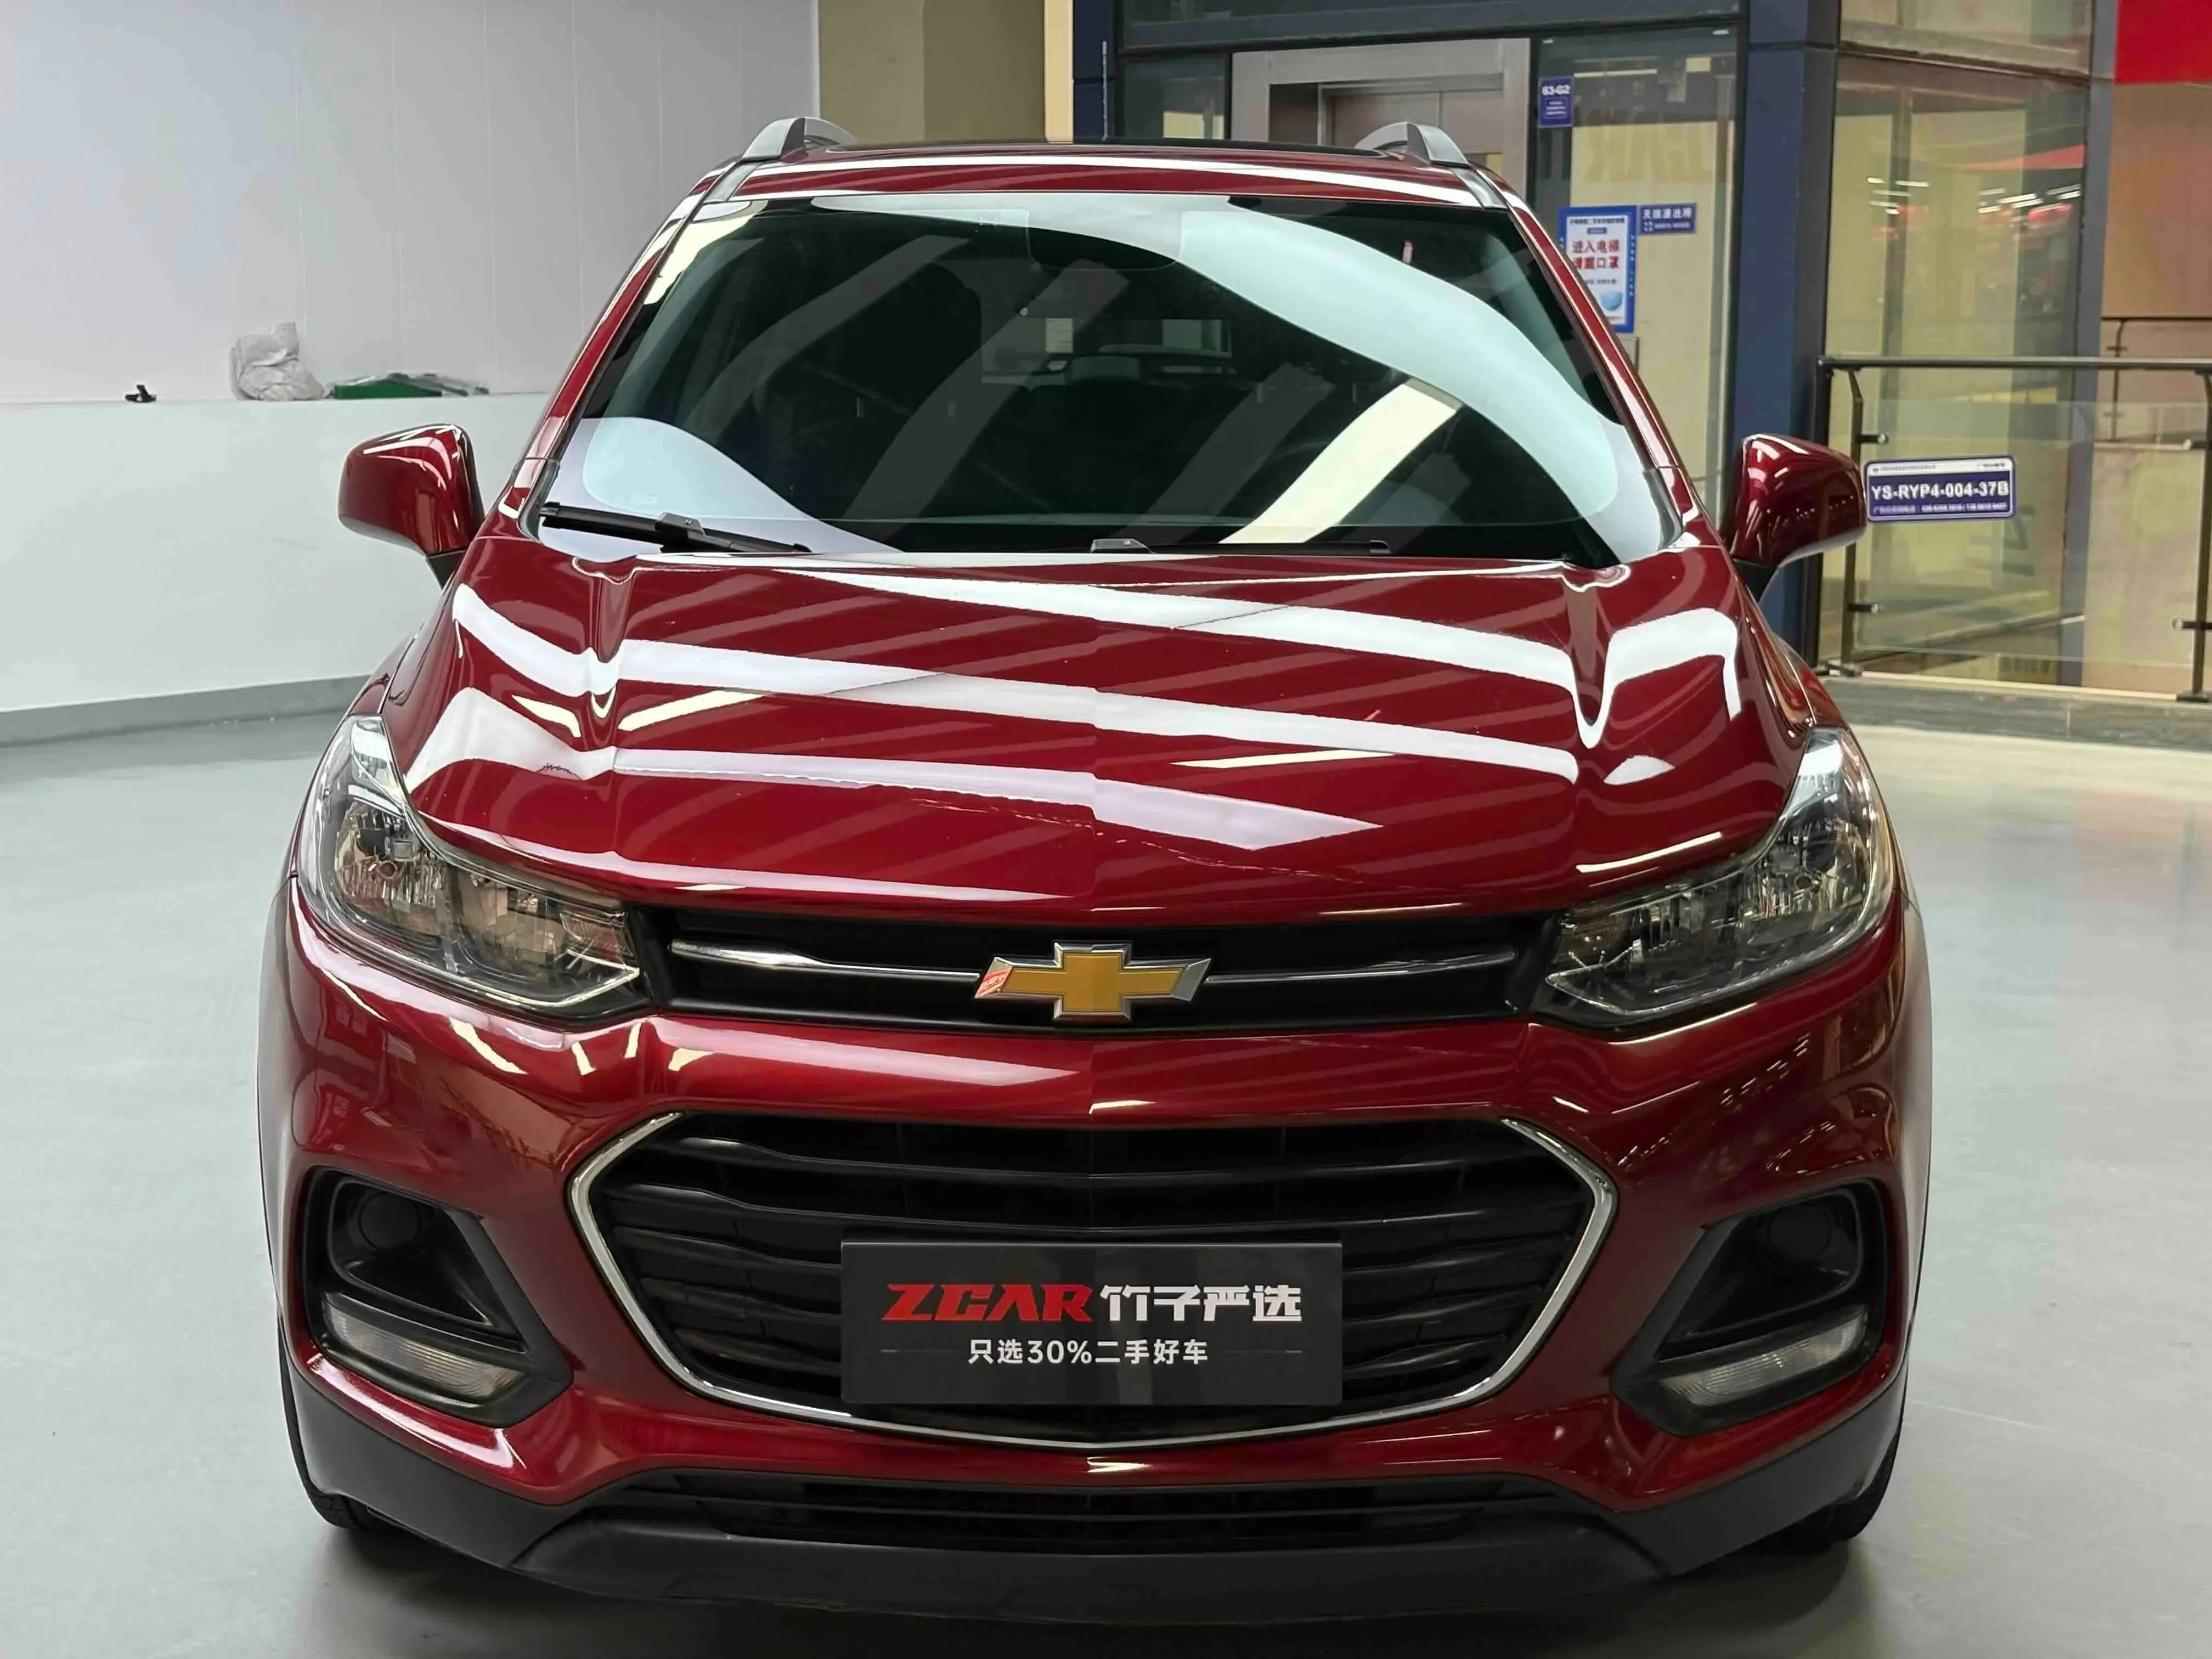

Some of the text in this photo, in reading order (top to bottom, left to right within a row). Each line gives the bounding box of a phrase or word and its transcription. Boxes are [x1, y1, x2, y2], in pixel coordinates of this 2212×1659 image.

[881, 1283, 1302, 1323] ZCAR 竹子严选
[968, 1339, 1209, 1365] 只选30%二手好车
